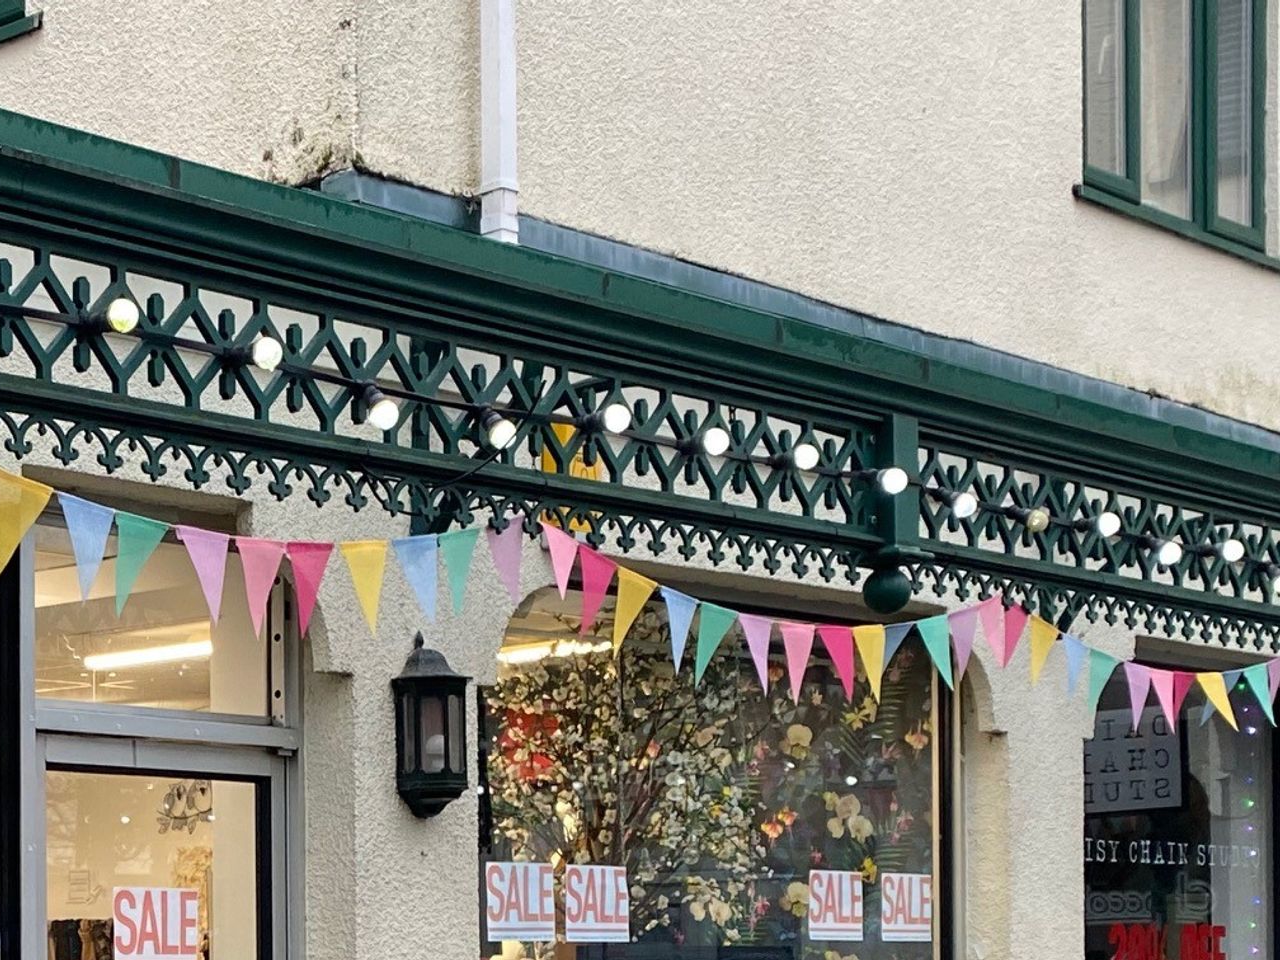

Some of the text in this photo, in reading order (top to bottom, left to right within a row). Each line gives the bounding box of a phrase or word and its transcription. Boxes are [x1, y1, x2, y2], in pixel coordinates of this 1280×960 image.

[1129, 840, 1189, 865] CHAIN
[487, 864, 555, 922] SALE
[567, 867, 628, 923] SALE
[809, 872, 863, 924] SALE
[882, 875, 932, 925] SALE
[114, 889, 198, 955] SALE
